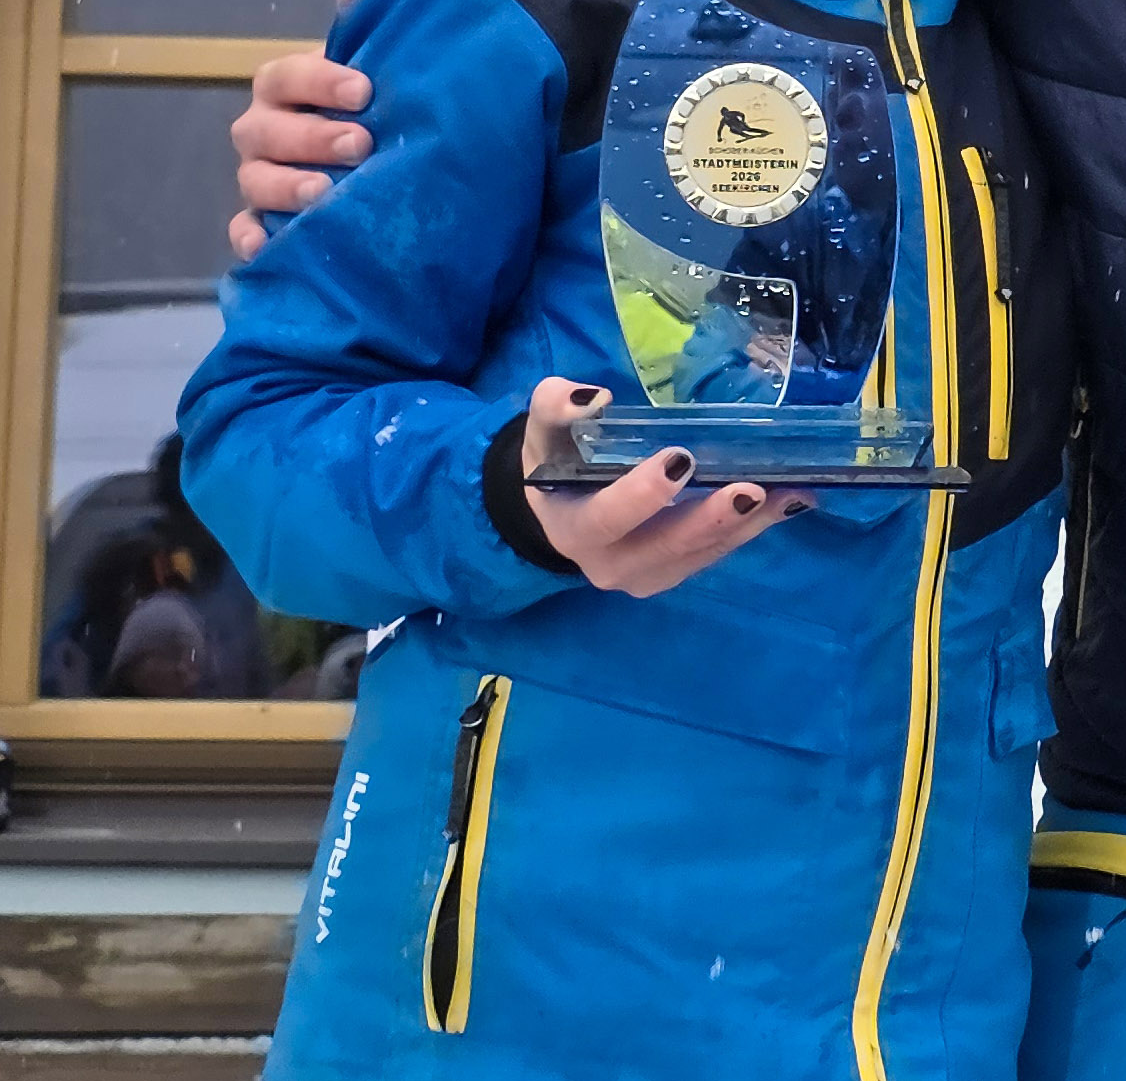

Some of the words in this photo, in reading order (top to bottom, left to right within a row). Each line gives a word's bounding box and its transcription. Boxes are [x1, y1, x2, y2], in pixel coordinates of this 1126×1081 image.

[692, 158, 798, 169] STADTMEISTERIN
[731, 171, 761, 182] 2026
[315, 771, 371, 944] VITALINI
